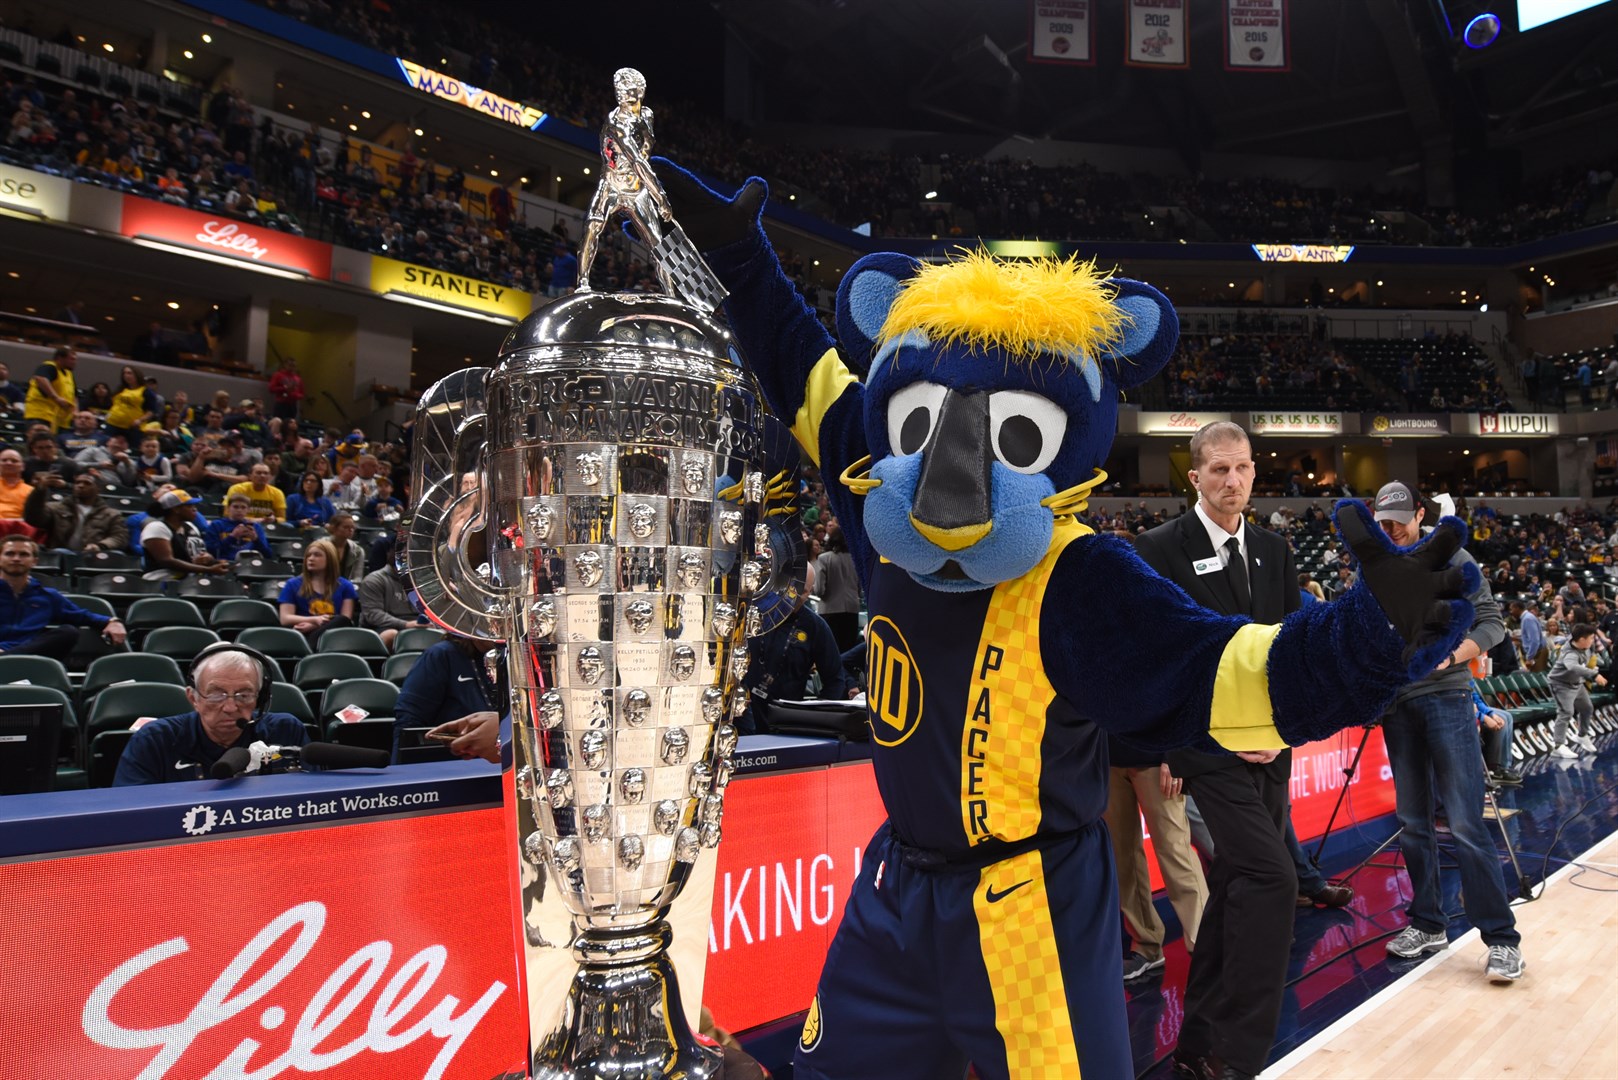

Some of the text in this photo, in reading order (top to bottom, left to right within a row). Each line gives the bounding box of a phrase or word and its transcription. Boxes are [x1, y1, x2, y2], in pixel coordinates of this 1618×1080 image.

[1049, 22, 1073, 34] 2009
[1144, 13, 1170, 27] 2012
[418, 73, 522, 127] MAD ANTS
[0, 178, 36, 199] se
[196, 221, 267, 259] Lilly
[1265, 247, 1336, 262] MAD ANTS
[404, 266, 504, 303] STANLEY
[1167, 413, 1202, 428] Lilly
[1389, 419, 1438, 428] LIGHTBOUND
[1503, 415, 1549, 433] IUPUI
[1291, 756, 1311, 800] HE
[1312, 747, 1361, 794] WORLD
[219, 791, 440, 826] A State that Works.com
[708, 853, 834, 954] KING
[82, 901, 508, 1080] Lilly
